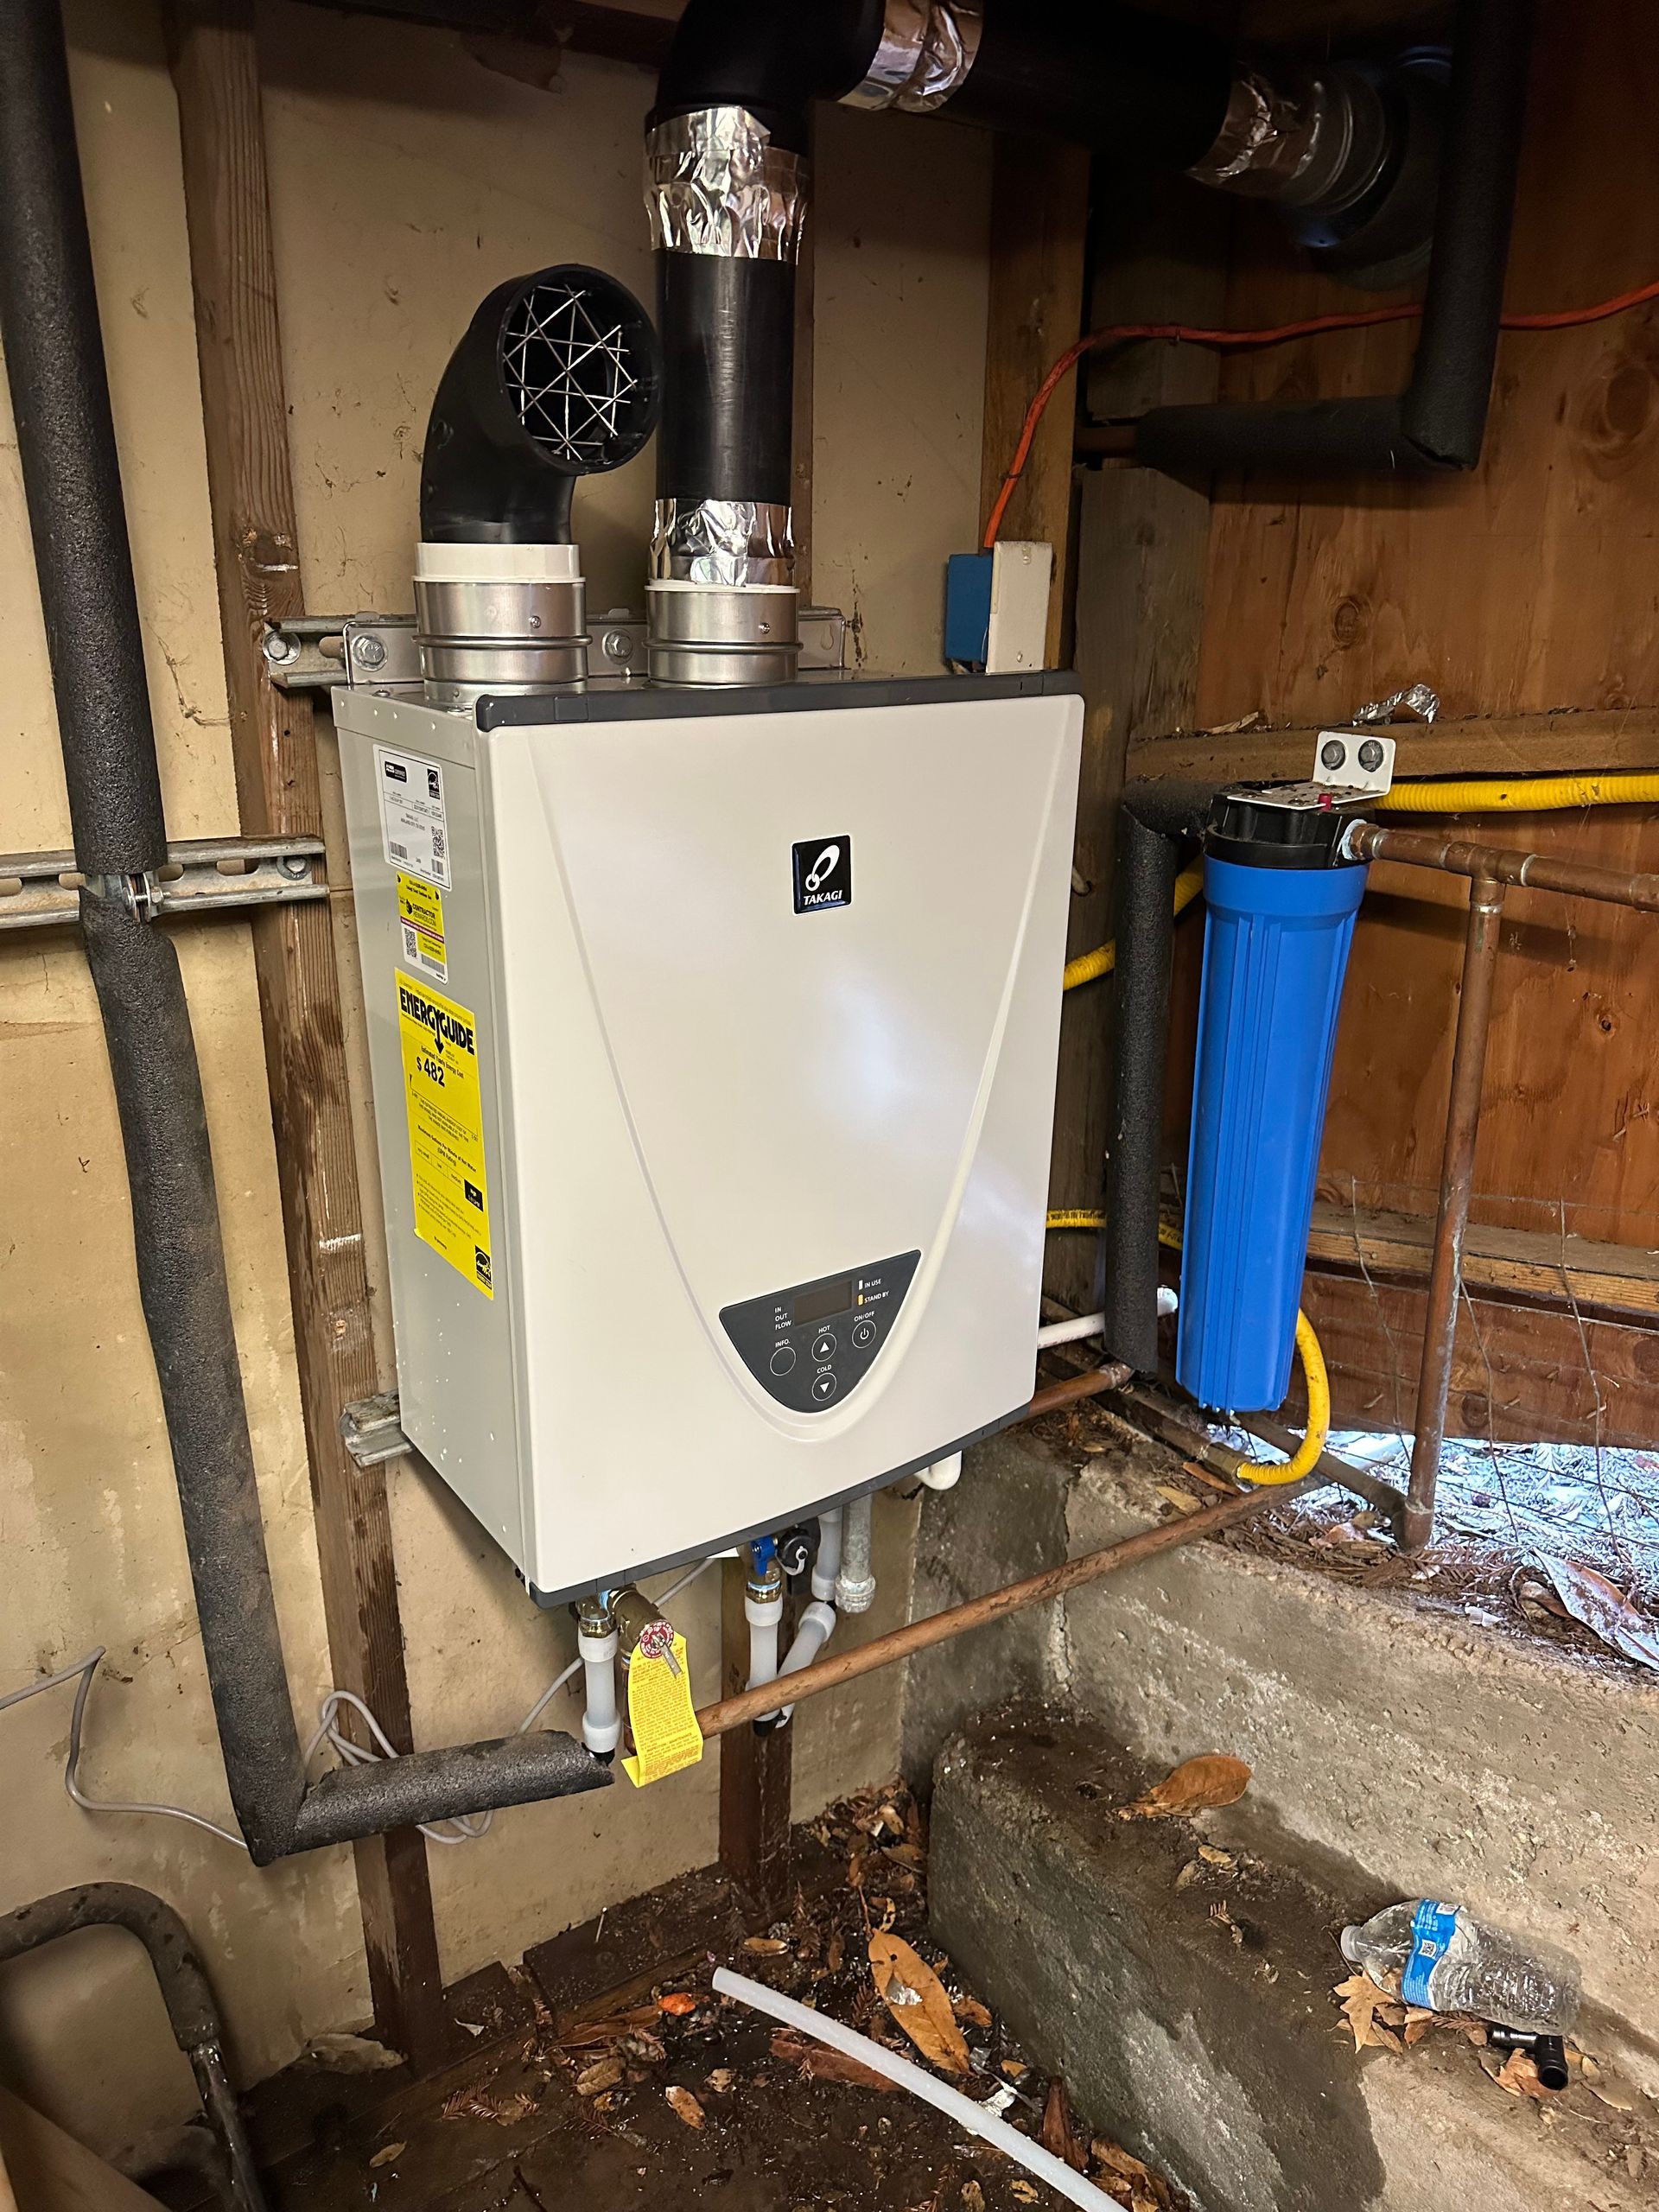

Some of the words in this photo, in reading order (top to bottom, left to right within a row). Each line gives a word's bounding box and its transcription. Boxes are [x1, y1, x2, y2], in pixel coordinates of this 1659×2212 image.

[803, 890, 843, 906] TAKAGI
[400, 986, 474, 1055] ENERGYGUIDE
[423, 1058, 445, 1088] 482
[864, 1294, 881, 1303] STAND
[774, 1313, 788, 1322] OUT
[854, 1311, 875, 1322] ON/OFF
[775, 1320, 791, 1331] FLOW
[818, 1325, 830, 1334] HOT
[817, 1364, 832, 1374] COLD
